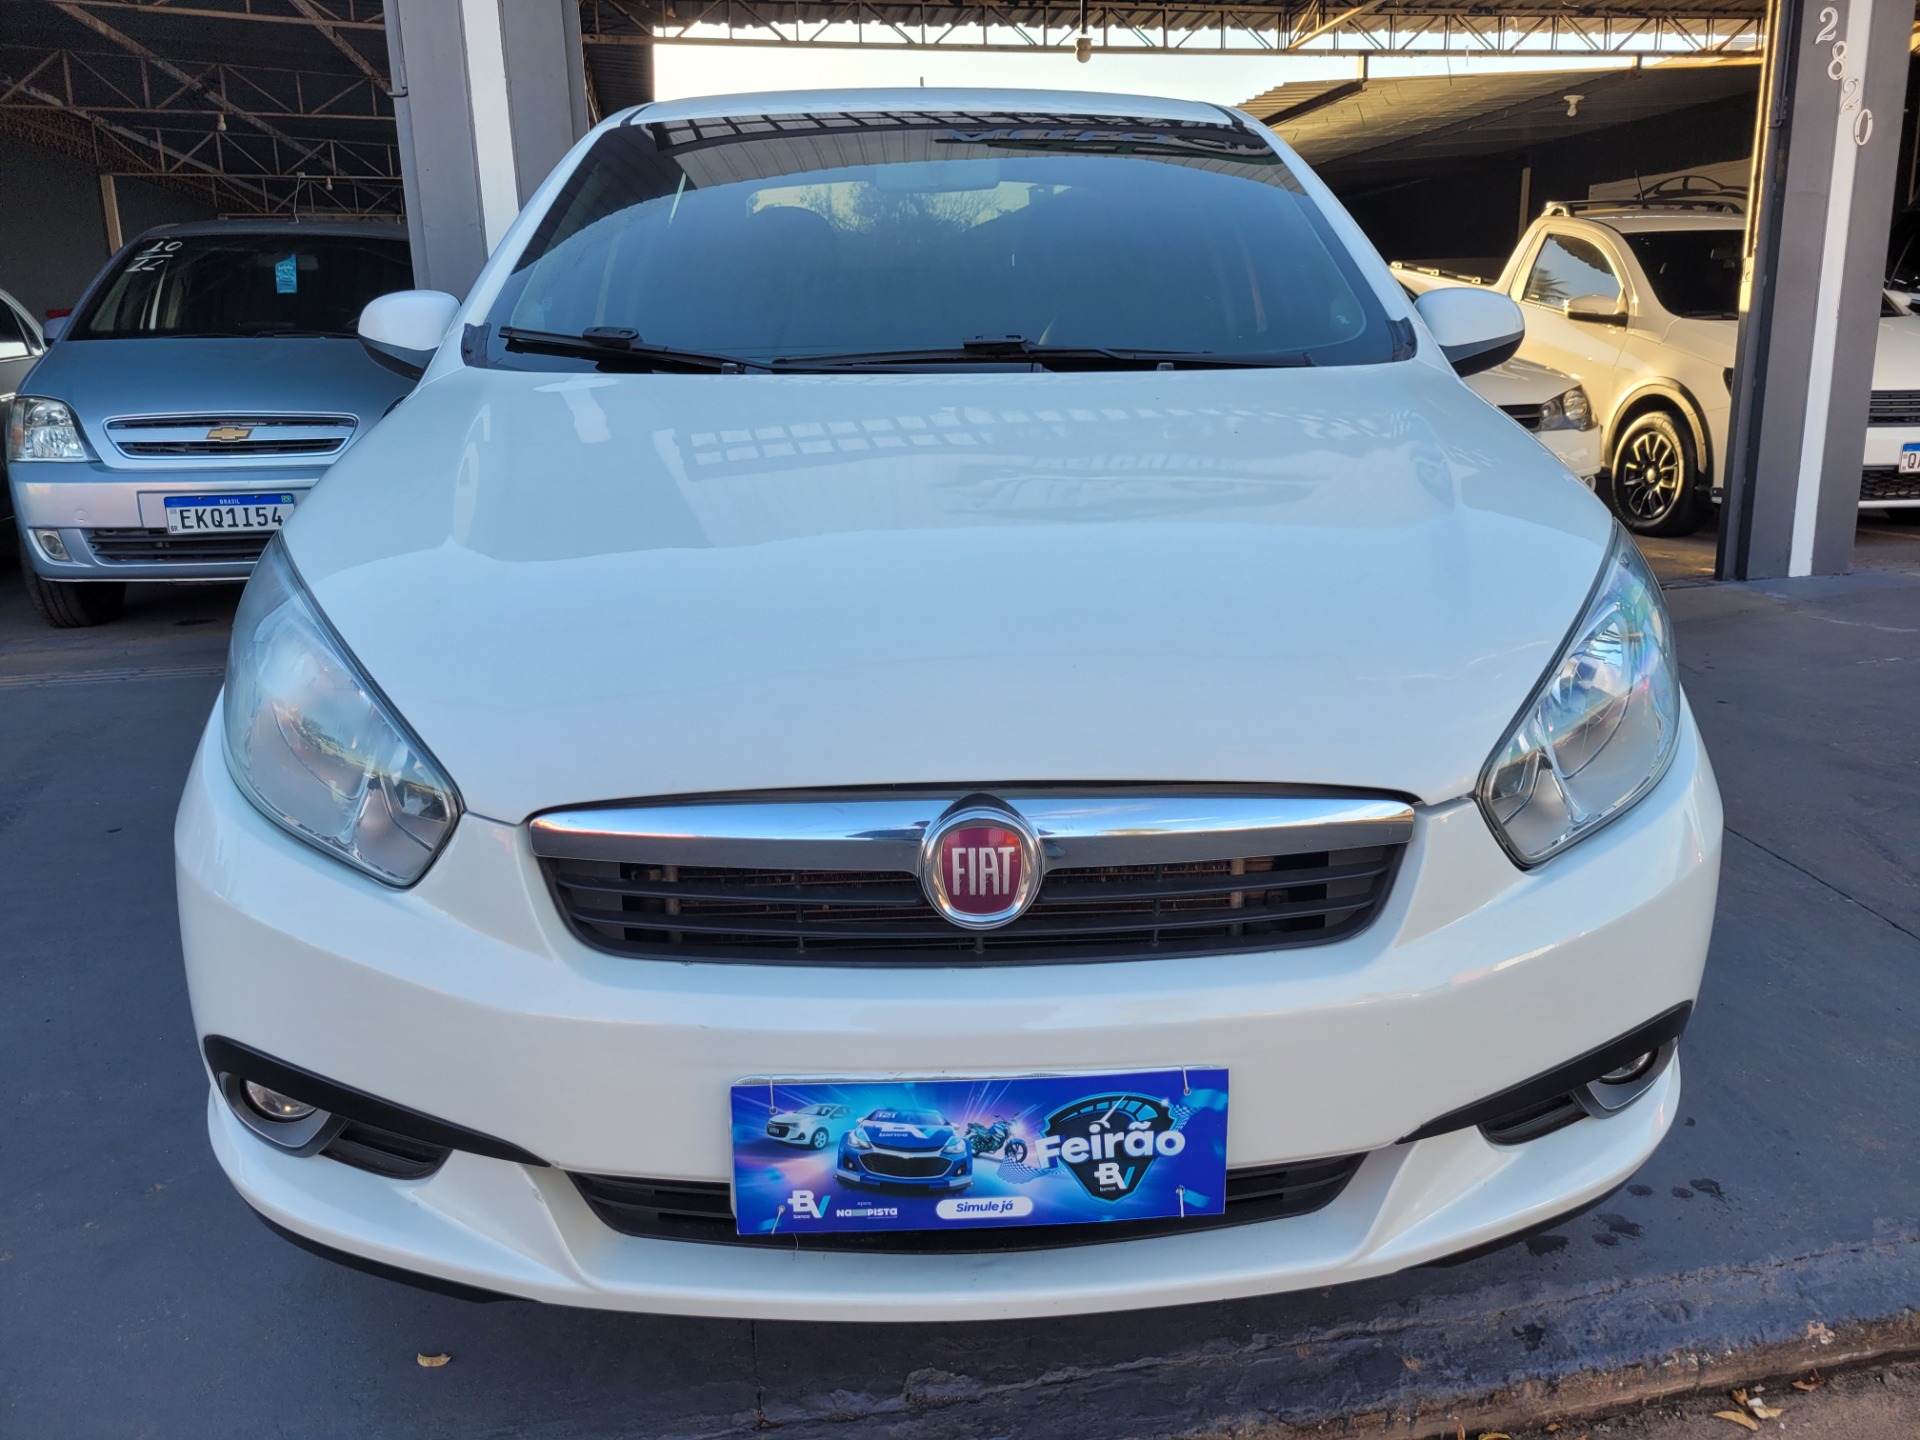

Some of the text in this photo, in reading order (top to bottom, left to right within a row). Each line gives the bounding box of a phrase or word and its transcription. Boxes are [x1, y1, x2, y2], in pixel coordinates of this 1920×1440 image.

[179, 506, 284, 529] EKQ1I54
[951, 846, 1015, 897] FIAT
[1034, 1121, 1186, 1170] Feirão
[956, 1199, 1014, 1213] Simule já
